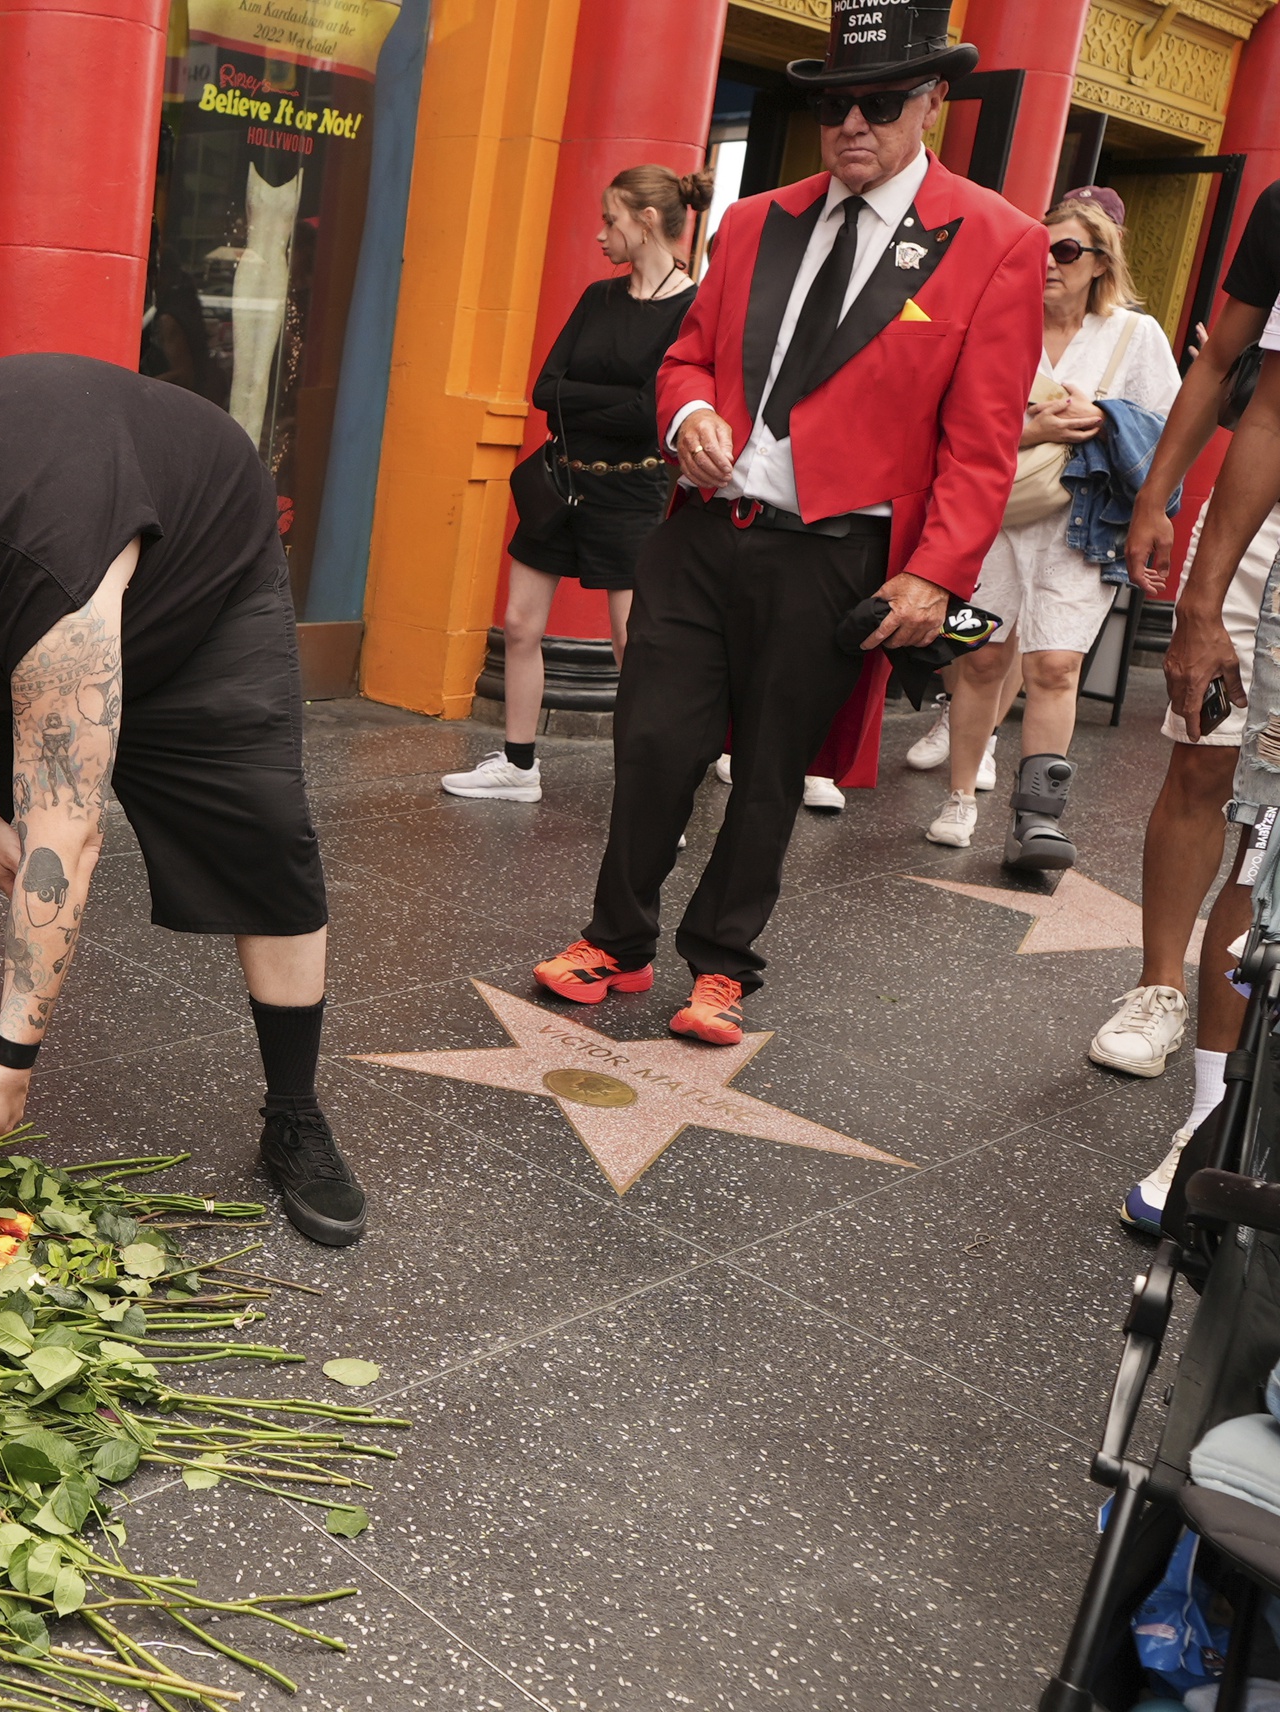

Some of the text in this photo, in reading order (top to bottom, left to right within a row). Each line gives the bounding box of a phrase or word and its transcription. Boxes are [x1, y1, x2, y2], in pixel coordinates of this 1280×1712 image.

[263, 3, 324, 28] Kardashian
[337, 23, 356, 36] the
[848, 12, 883, 27] STAR
[253, 24, 338, 55] 2022 Met Gala!
[843, 29, 887, 45] TOURS
[220, 64, 273, 97] Ripley's
[198, 83, 362, 139] Believe It or Not!
[247, 126, 314, 155] HOLLYWOOD
[1245, 856, 1263, 883] YOYO
[1254, 806, 1279, 849] BABYZEN
[539, 1025, 770, 1120] VICTOR MATURE
